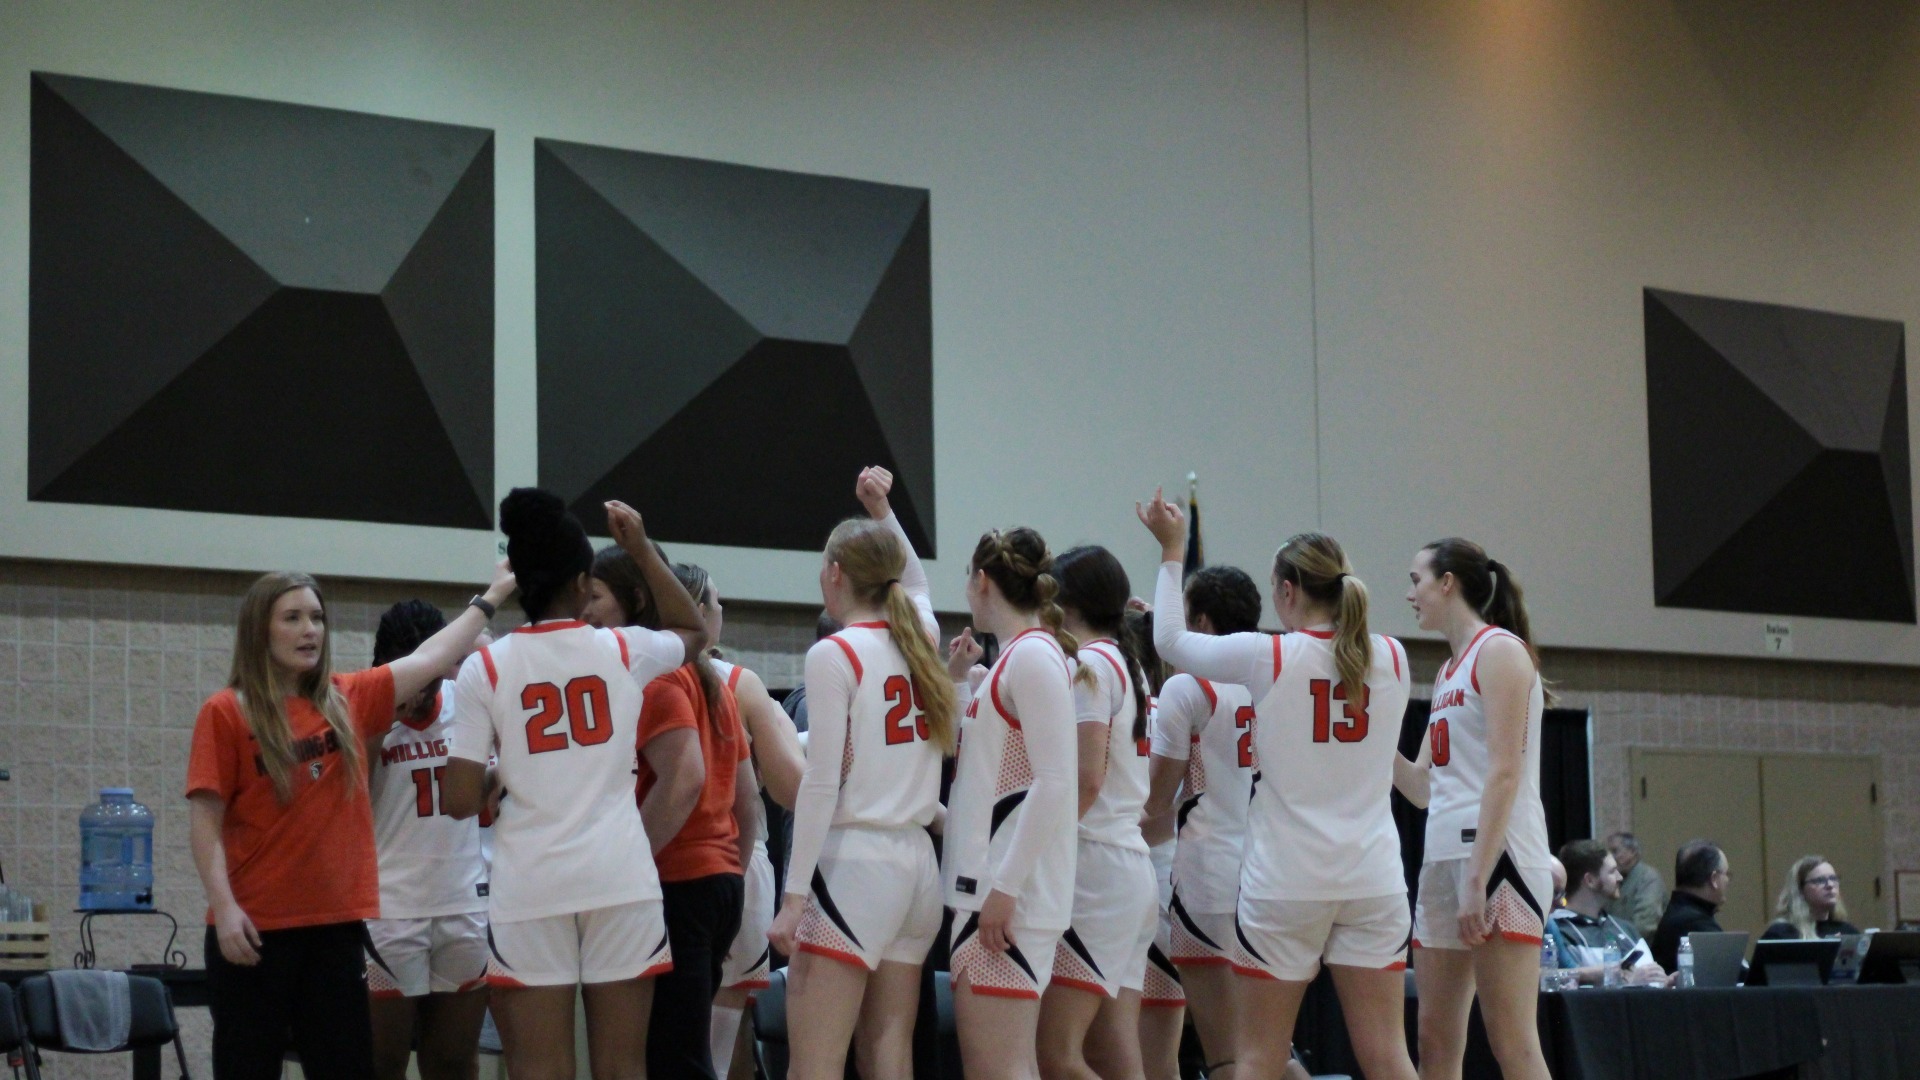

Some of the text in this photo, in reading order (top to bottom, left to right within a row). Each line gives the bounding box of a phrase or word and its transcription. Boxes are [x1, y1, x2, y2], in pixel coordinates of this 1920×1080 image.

[1775, 636, 1782, 650] 7
[520, 674, 614, 755] 20
[1309, 678, 1370, 743] 13
[1431, 688, 1465, 714] LLIGAN
[380, 738, 450, 768] MILLIG
